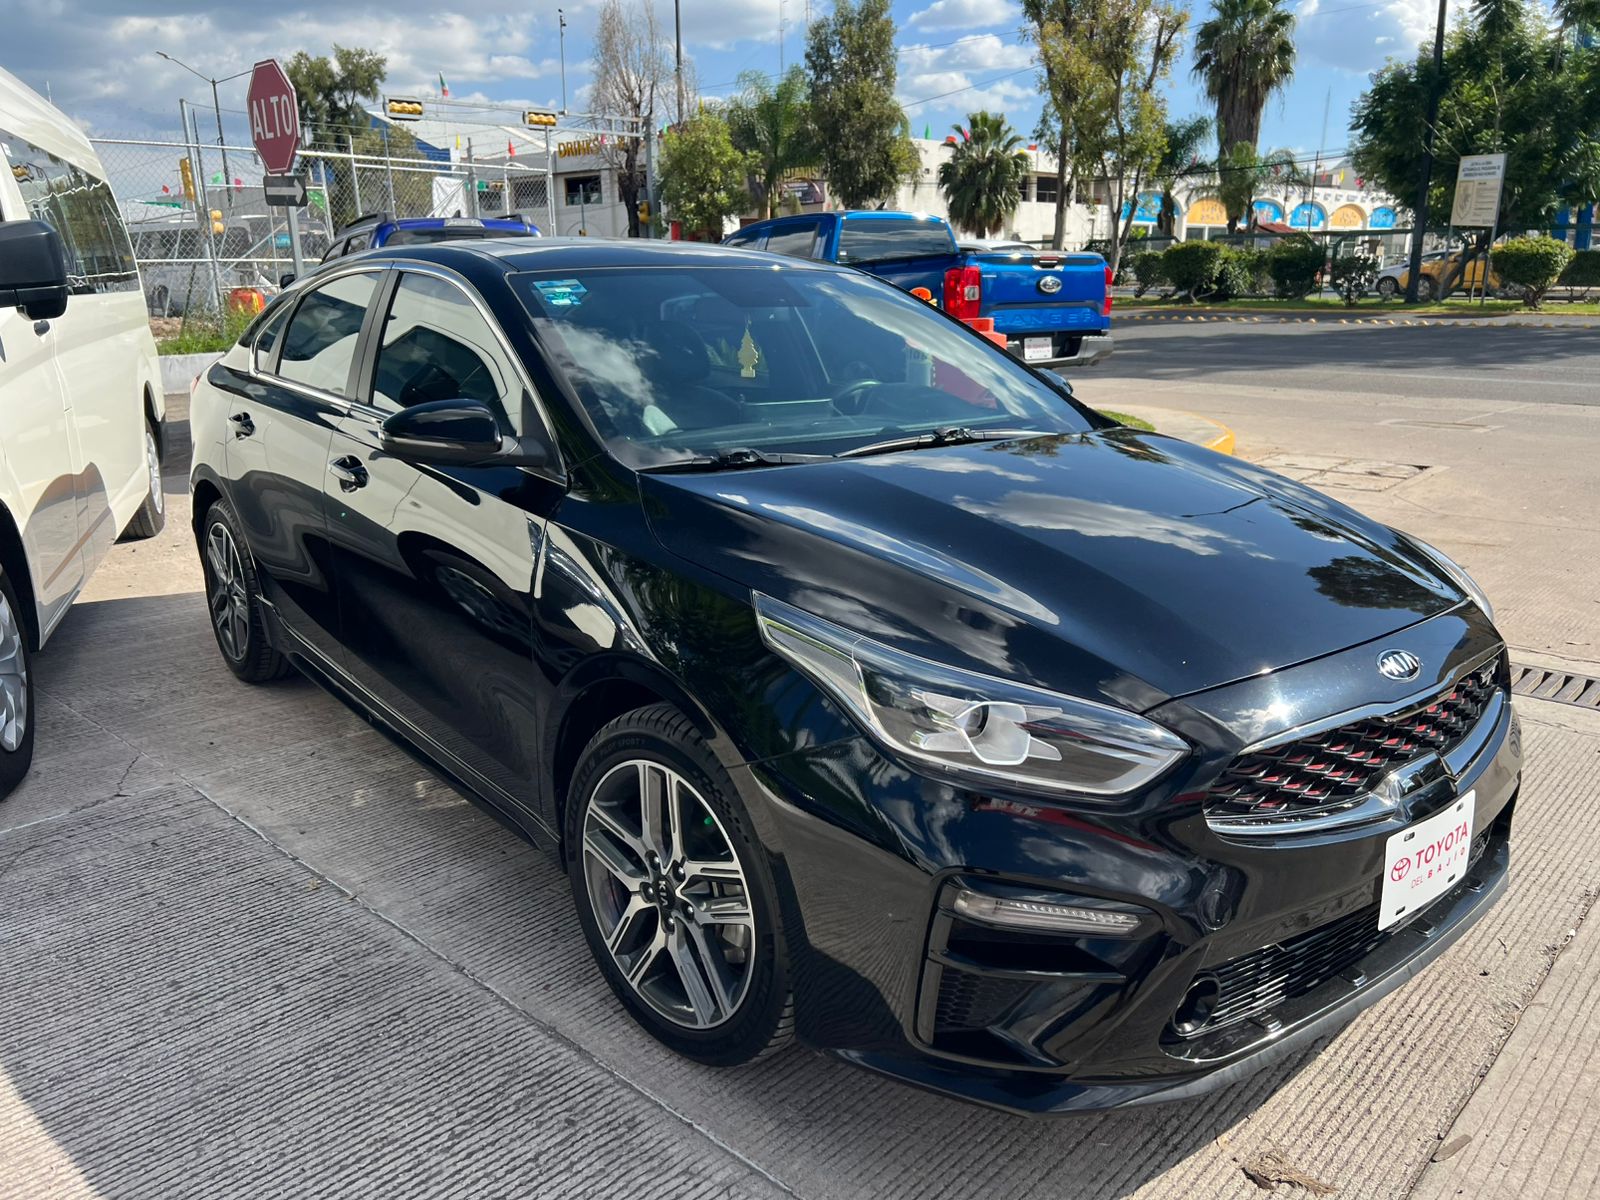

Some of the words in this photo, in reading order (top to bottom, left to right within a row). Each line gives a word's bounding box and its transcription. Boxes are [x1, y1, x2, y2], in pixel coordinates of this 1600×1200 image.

[252, 94, 293, 141] ALTO
[557, 139, 601, 158] DRINKS
[1379, 652, 1418, 676] KIA
[1415, 821, 1468, 869] TOYOTA
[658, 880, 669, 906] KIA
[1411, 876, 1423, 889] DEL
